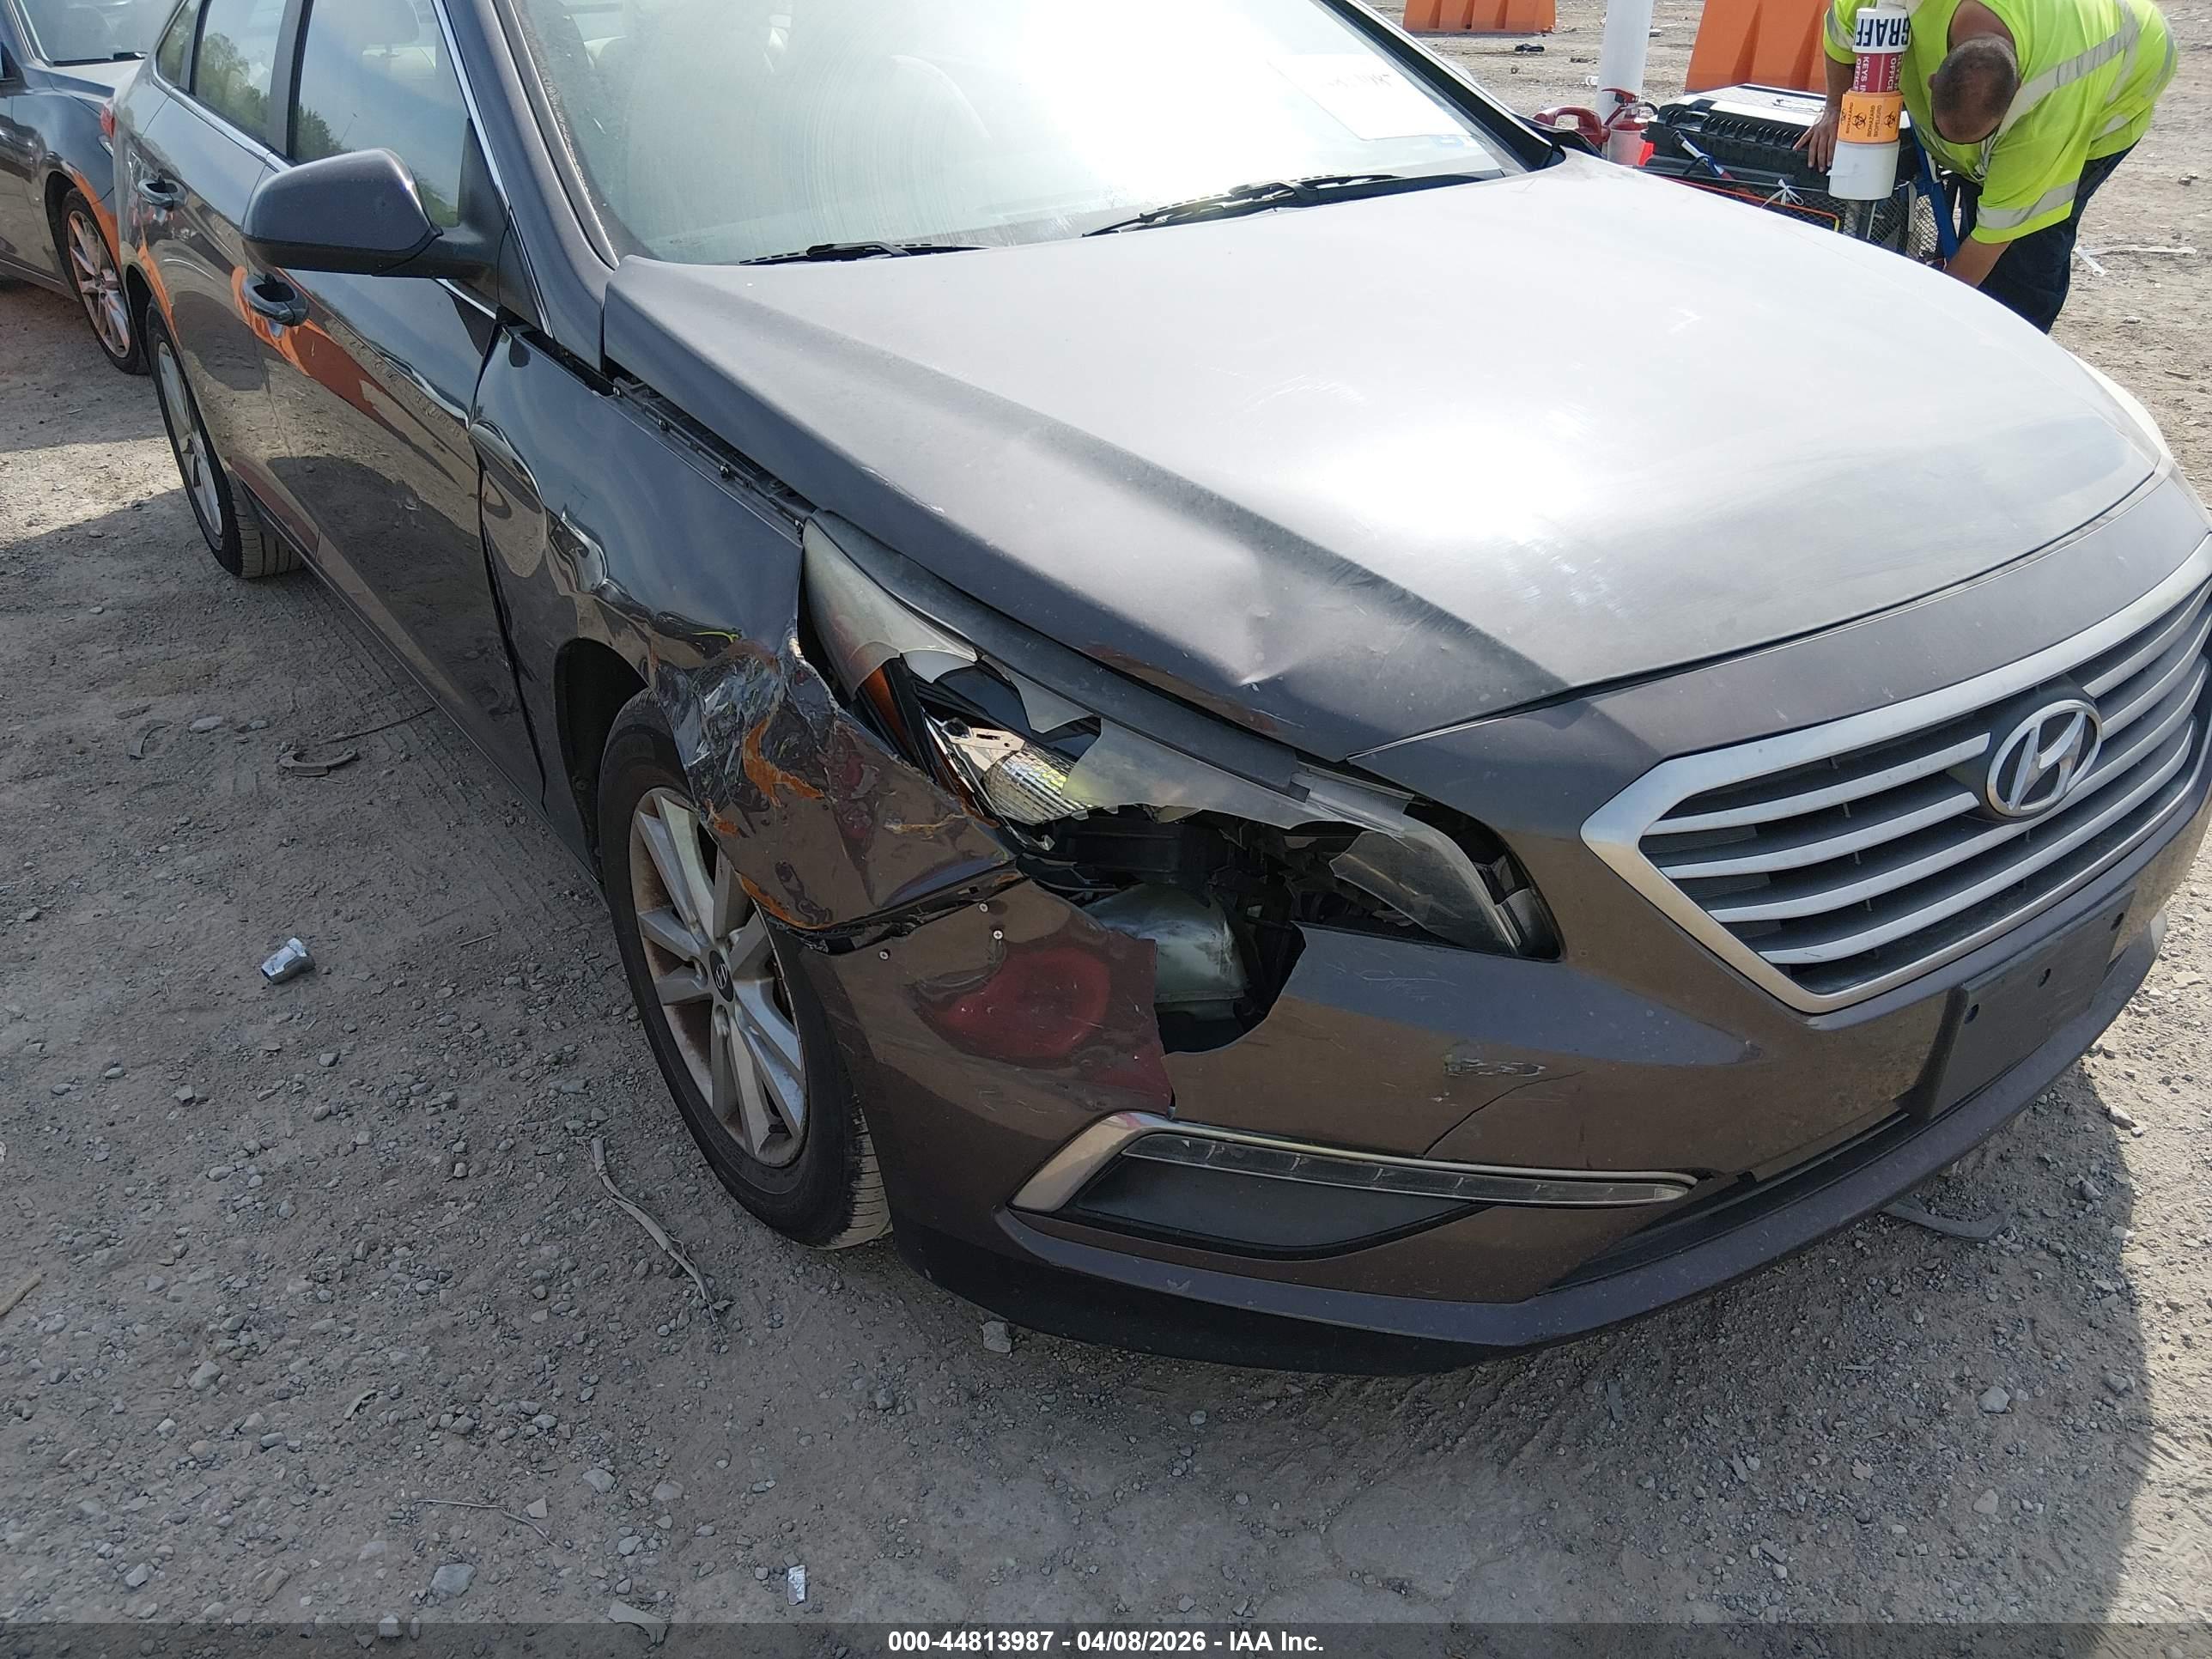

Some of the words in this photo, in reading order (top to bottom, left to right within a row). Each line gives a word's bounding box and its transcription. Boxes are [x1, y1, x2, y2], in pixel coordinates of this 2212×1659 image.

[1861, 56, 1870, 82] KEYS
[1887, 58, 1896, 91] OFFICE
[1867, 105, 1875, 137] BIOHAZARD
